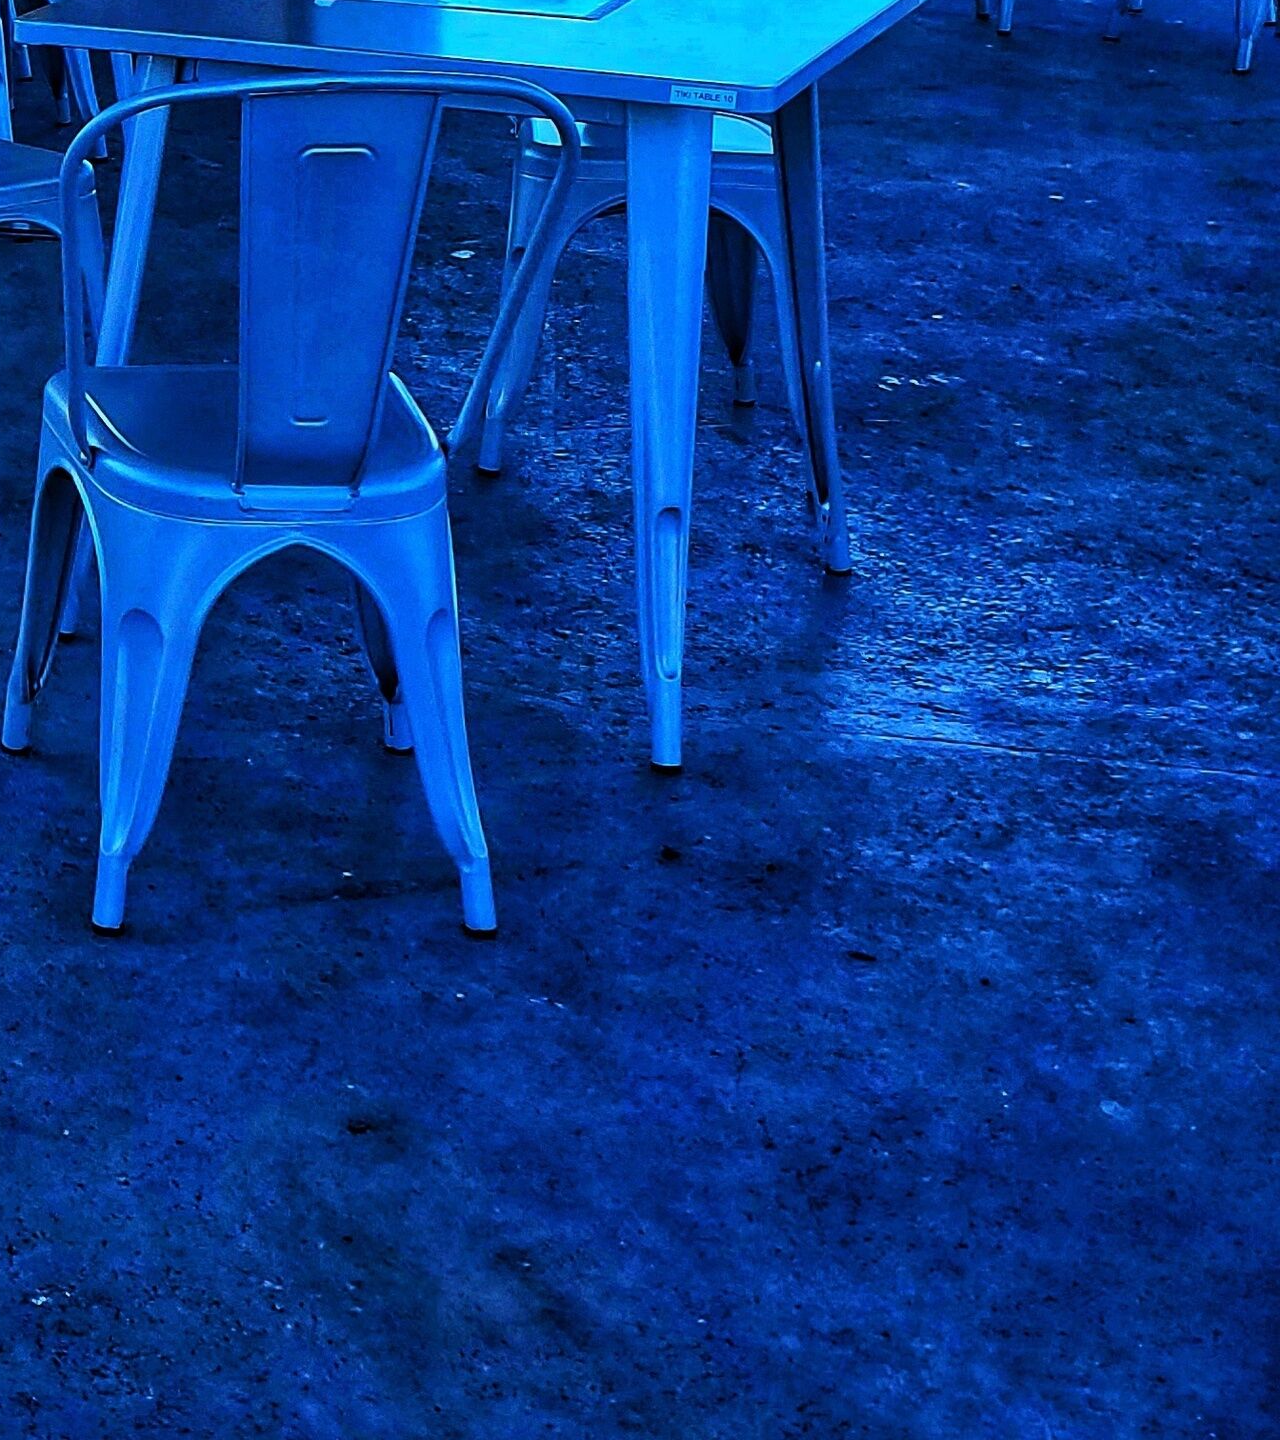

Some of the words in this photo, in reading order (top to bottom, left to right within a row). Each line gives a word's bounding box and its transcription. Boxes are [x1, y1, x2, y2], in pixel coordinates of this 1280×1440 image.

[674, 89, 691, 99] TIKI
[693, 92, 721, 102] TABLE
[723, 95, 734, 104] 10
